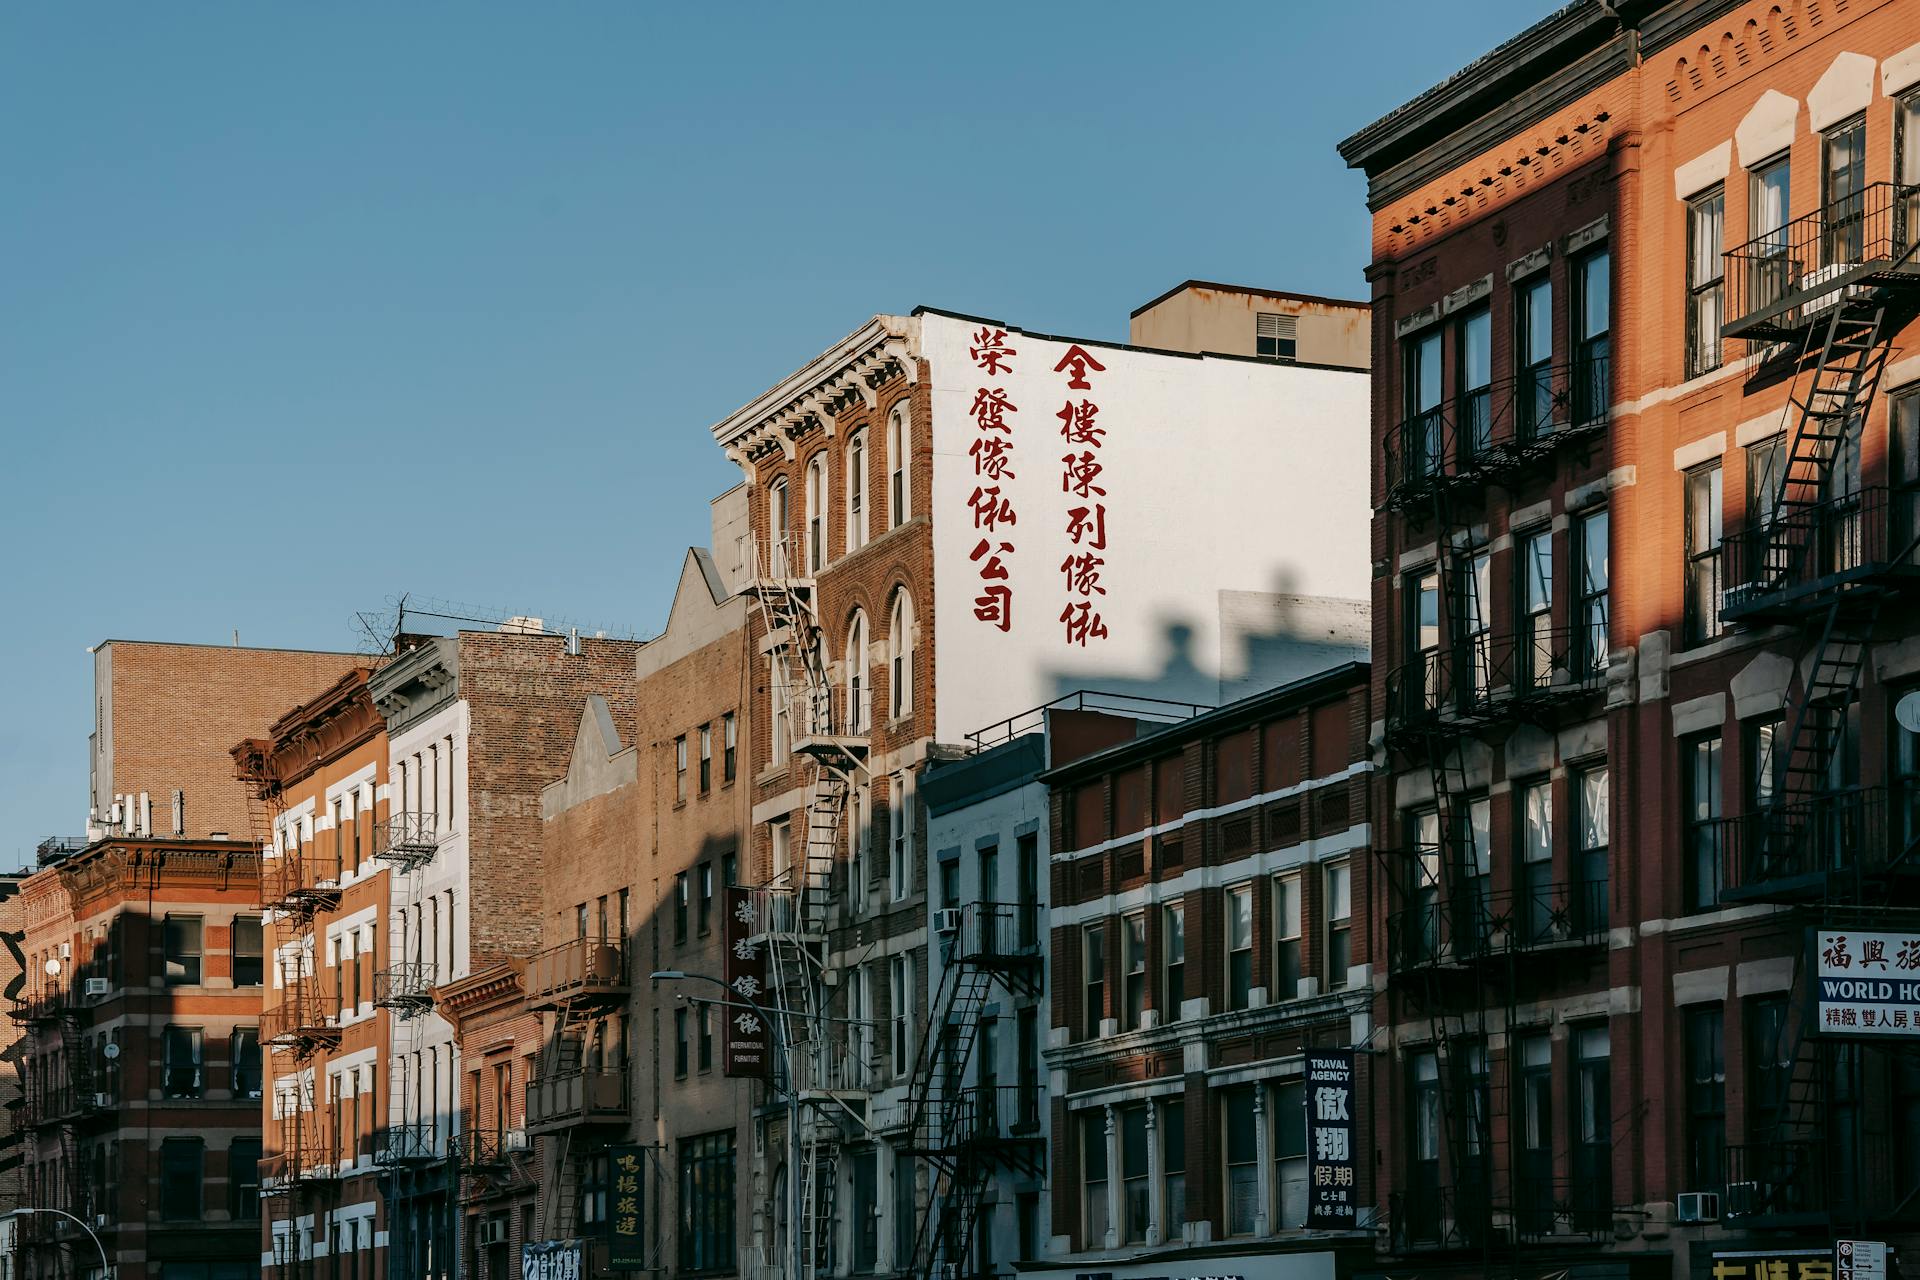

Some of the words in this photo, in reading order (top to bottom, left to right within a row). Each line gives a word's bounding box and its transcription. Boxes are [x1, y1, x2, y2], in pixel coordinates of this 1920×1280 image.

[1053, 344, 1107, 647] 全樓陳列傢俬
[1823, 981, 1893, 1000] WORLD
[730, 1041, 764, 1050] INTERNATIONAL
[734, 1055, 760, 1063] FURNITURE
[1311, 1059, 1348, 1070] TRAVAL
[1310, 1071, 1350, 1081] AGENCY
[1314, 1165, 1353, 1186] 假期
